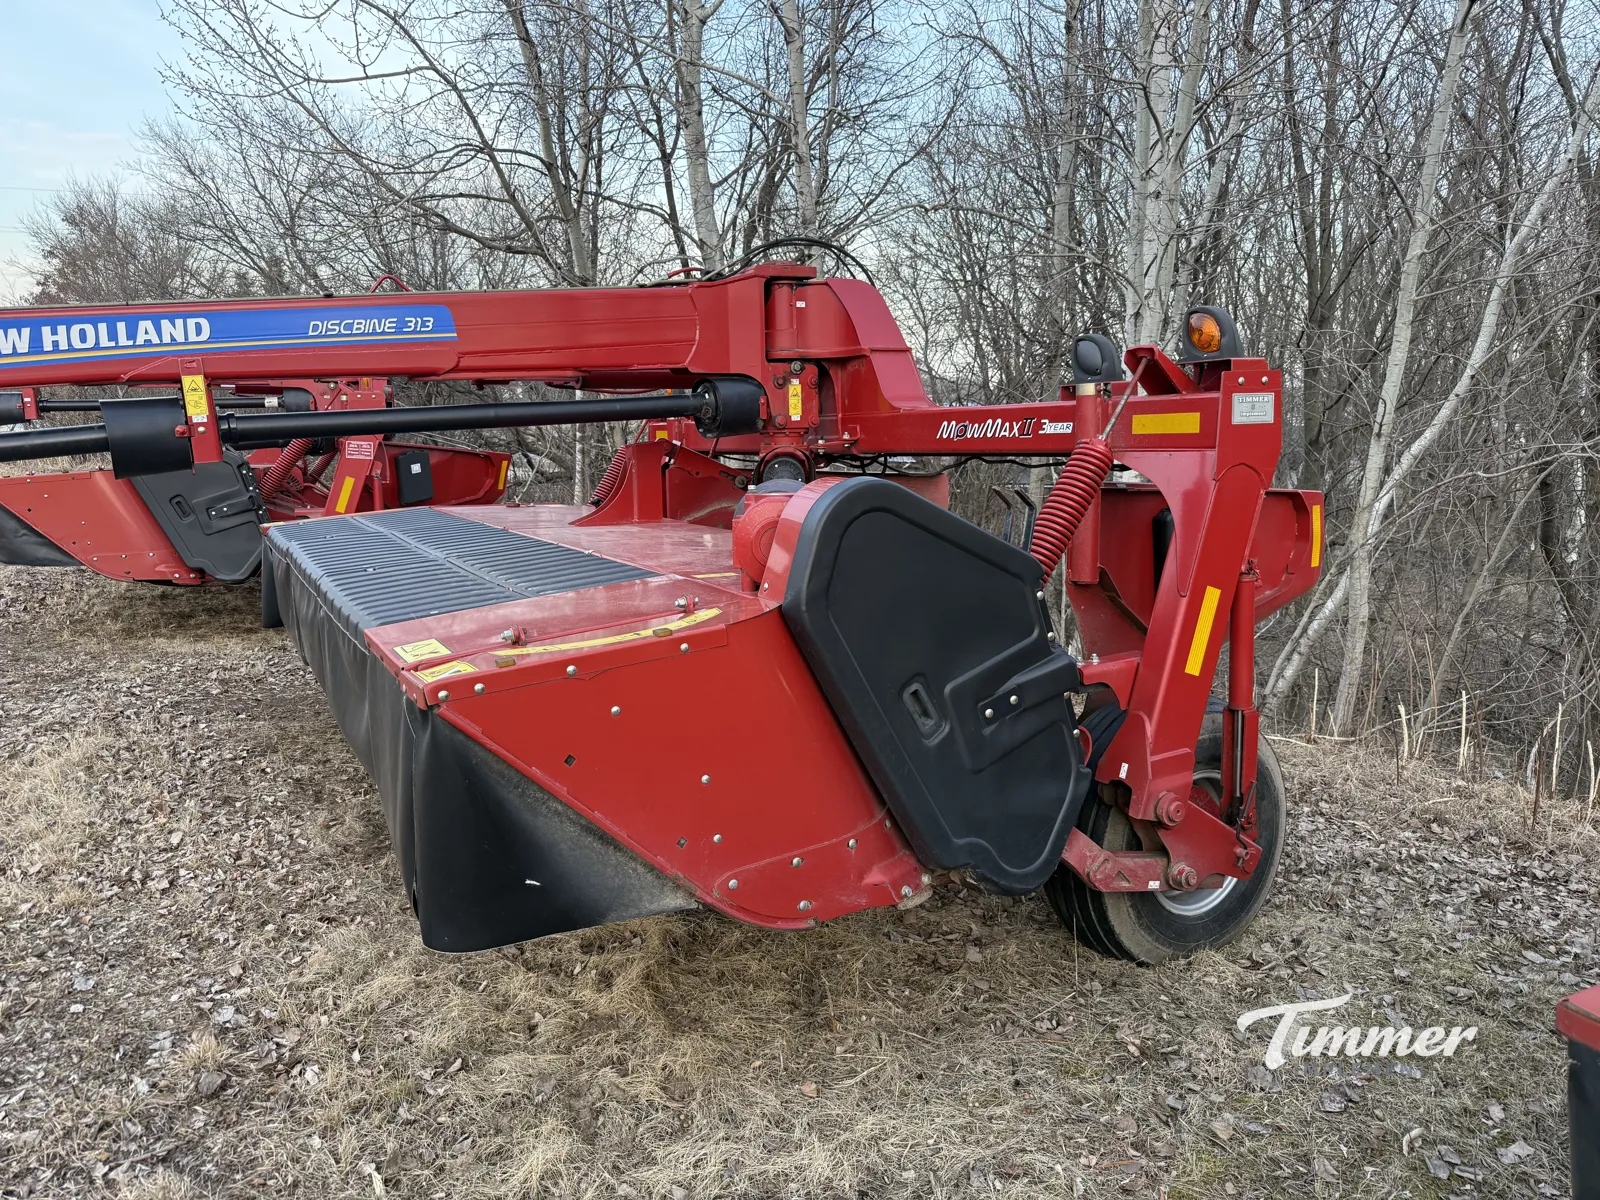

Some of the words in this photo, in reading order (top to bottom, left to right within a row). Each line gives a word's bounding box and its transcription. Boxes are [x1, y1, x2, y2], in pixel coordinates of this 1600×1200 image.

[0, 327, 31, 355] W
[41, 317, 211, 352] HOLLAND
[308, 318, 398, 336] DISCBINE
[403, 317, 434, 331] 313
